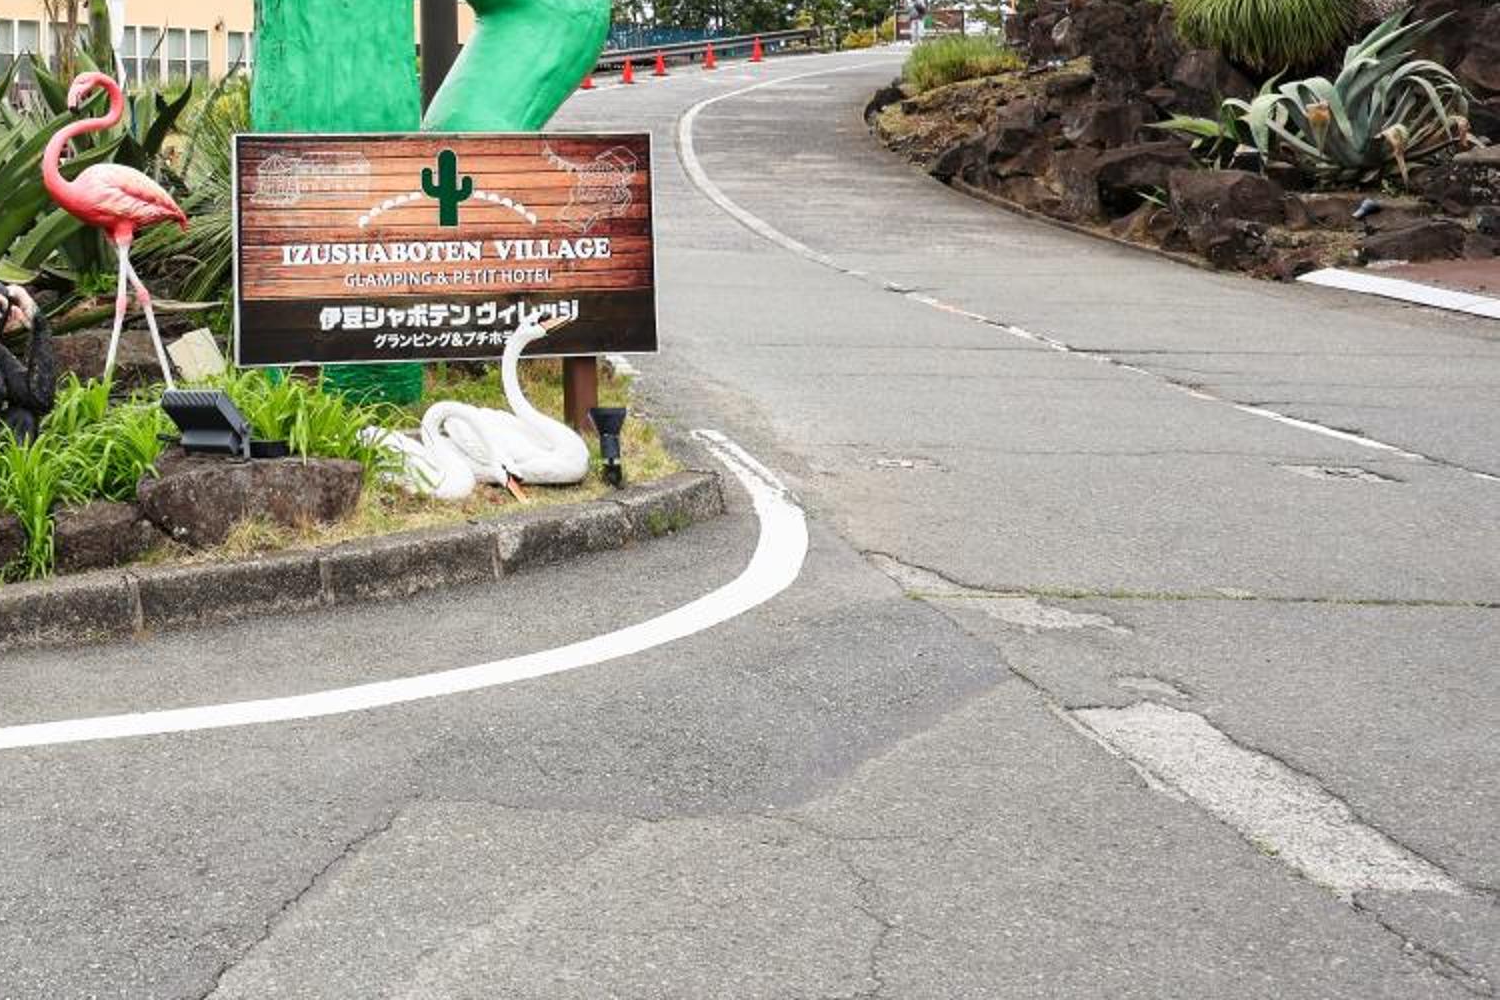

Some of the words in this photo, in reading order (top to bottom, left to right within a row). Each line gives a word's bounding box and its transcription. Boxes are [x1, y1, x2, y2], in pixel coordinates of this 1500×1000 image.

[281, 240, 484, 266] IZUSHABOTEN
[494, 237, 612, 260] VILLAGE
[344, 270, 431, 287] GLAMPING
[436, 270, 449, 286] &
[453, 270, 500, 285] PETIT
[502, 269, 552, 283] HOTEL
